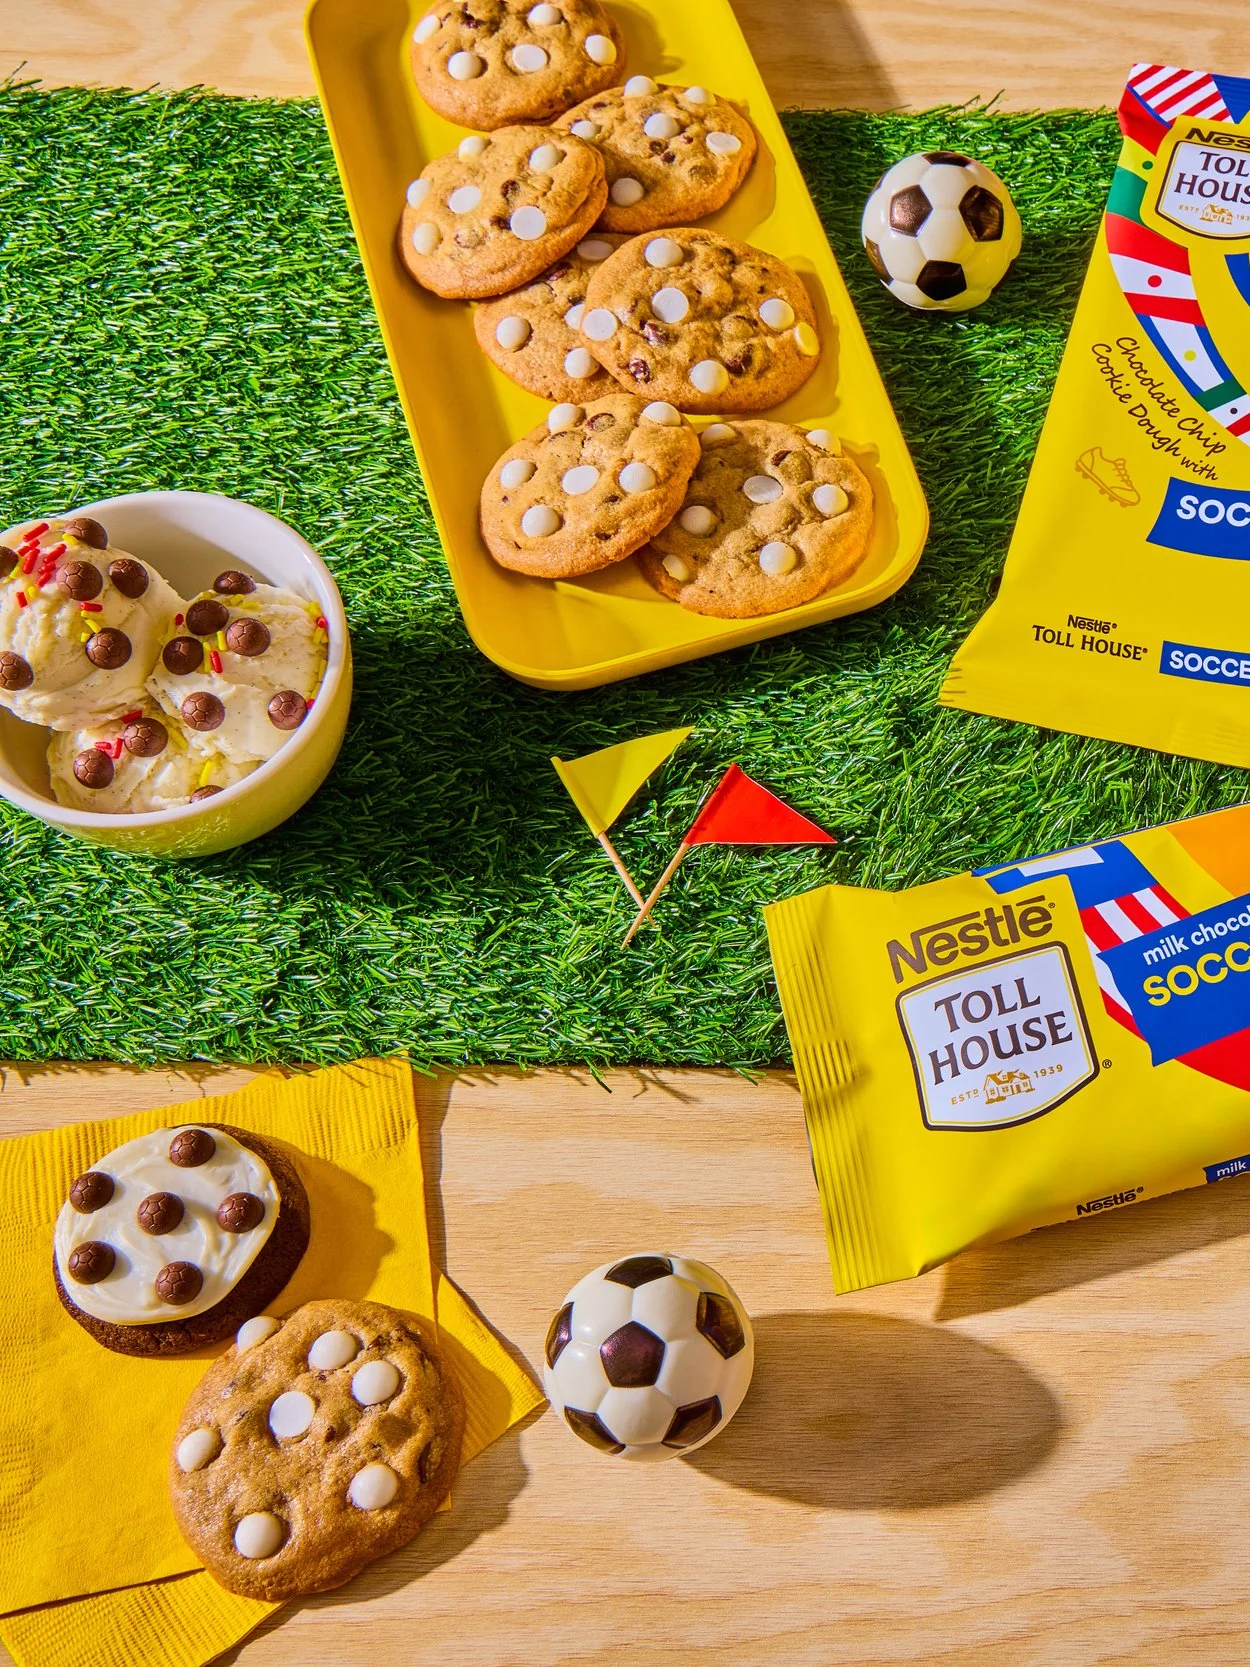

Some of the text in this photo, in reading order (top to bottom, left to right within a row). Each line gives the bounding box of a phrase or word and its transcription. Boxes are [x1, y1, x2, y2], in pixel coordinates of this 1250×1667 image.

[1091, 343, 1219, 481] Cookie Dough with
[1116, 337, 1226, 457] Chocolate Chip
[1032, 625, 1143, 661] TOLL HOUSE
[1143, 934, 1189, 966] milk
[933, 976, 1042, 1034] TOLL
[928, 1011, 1074, 1086] HOUSE
[1033, 1064, 1063, 1079] 1939
[1216, 1160, 1247, 1178] milk
